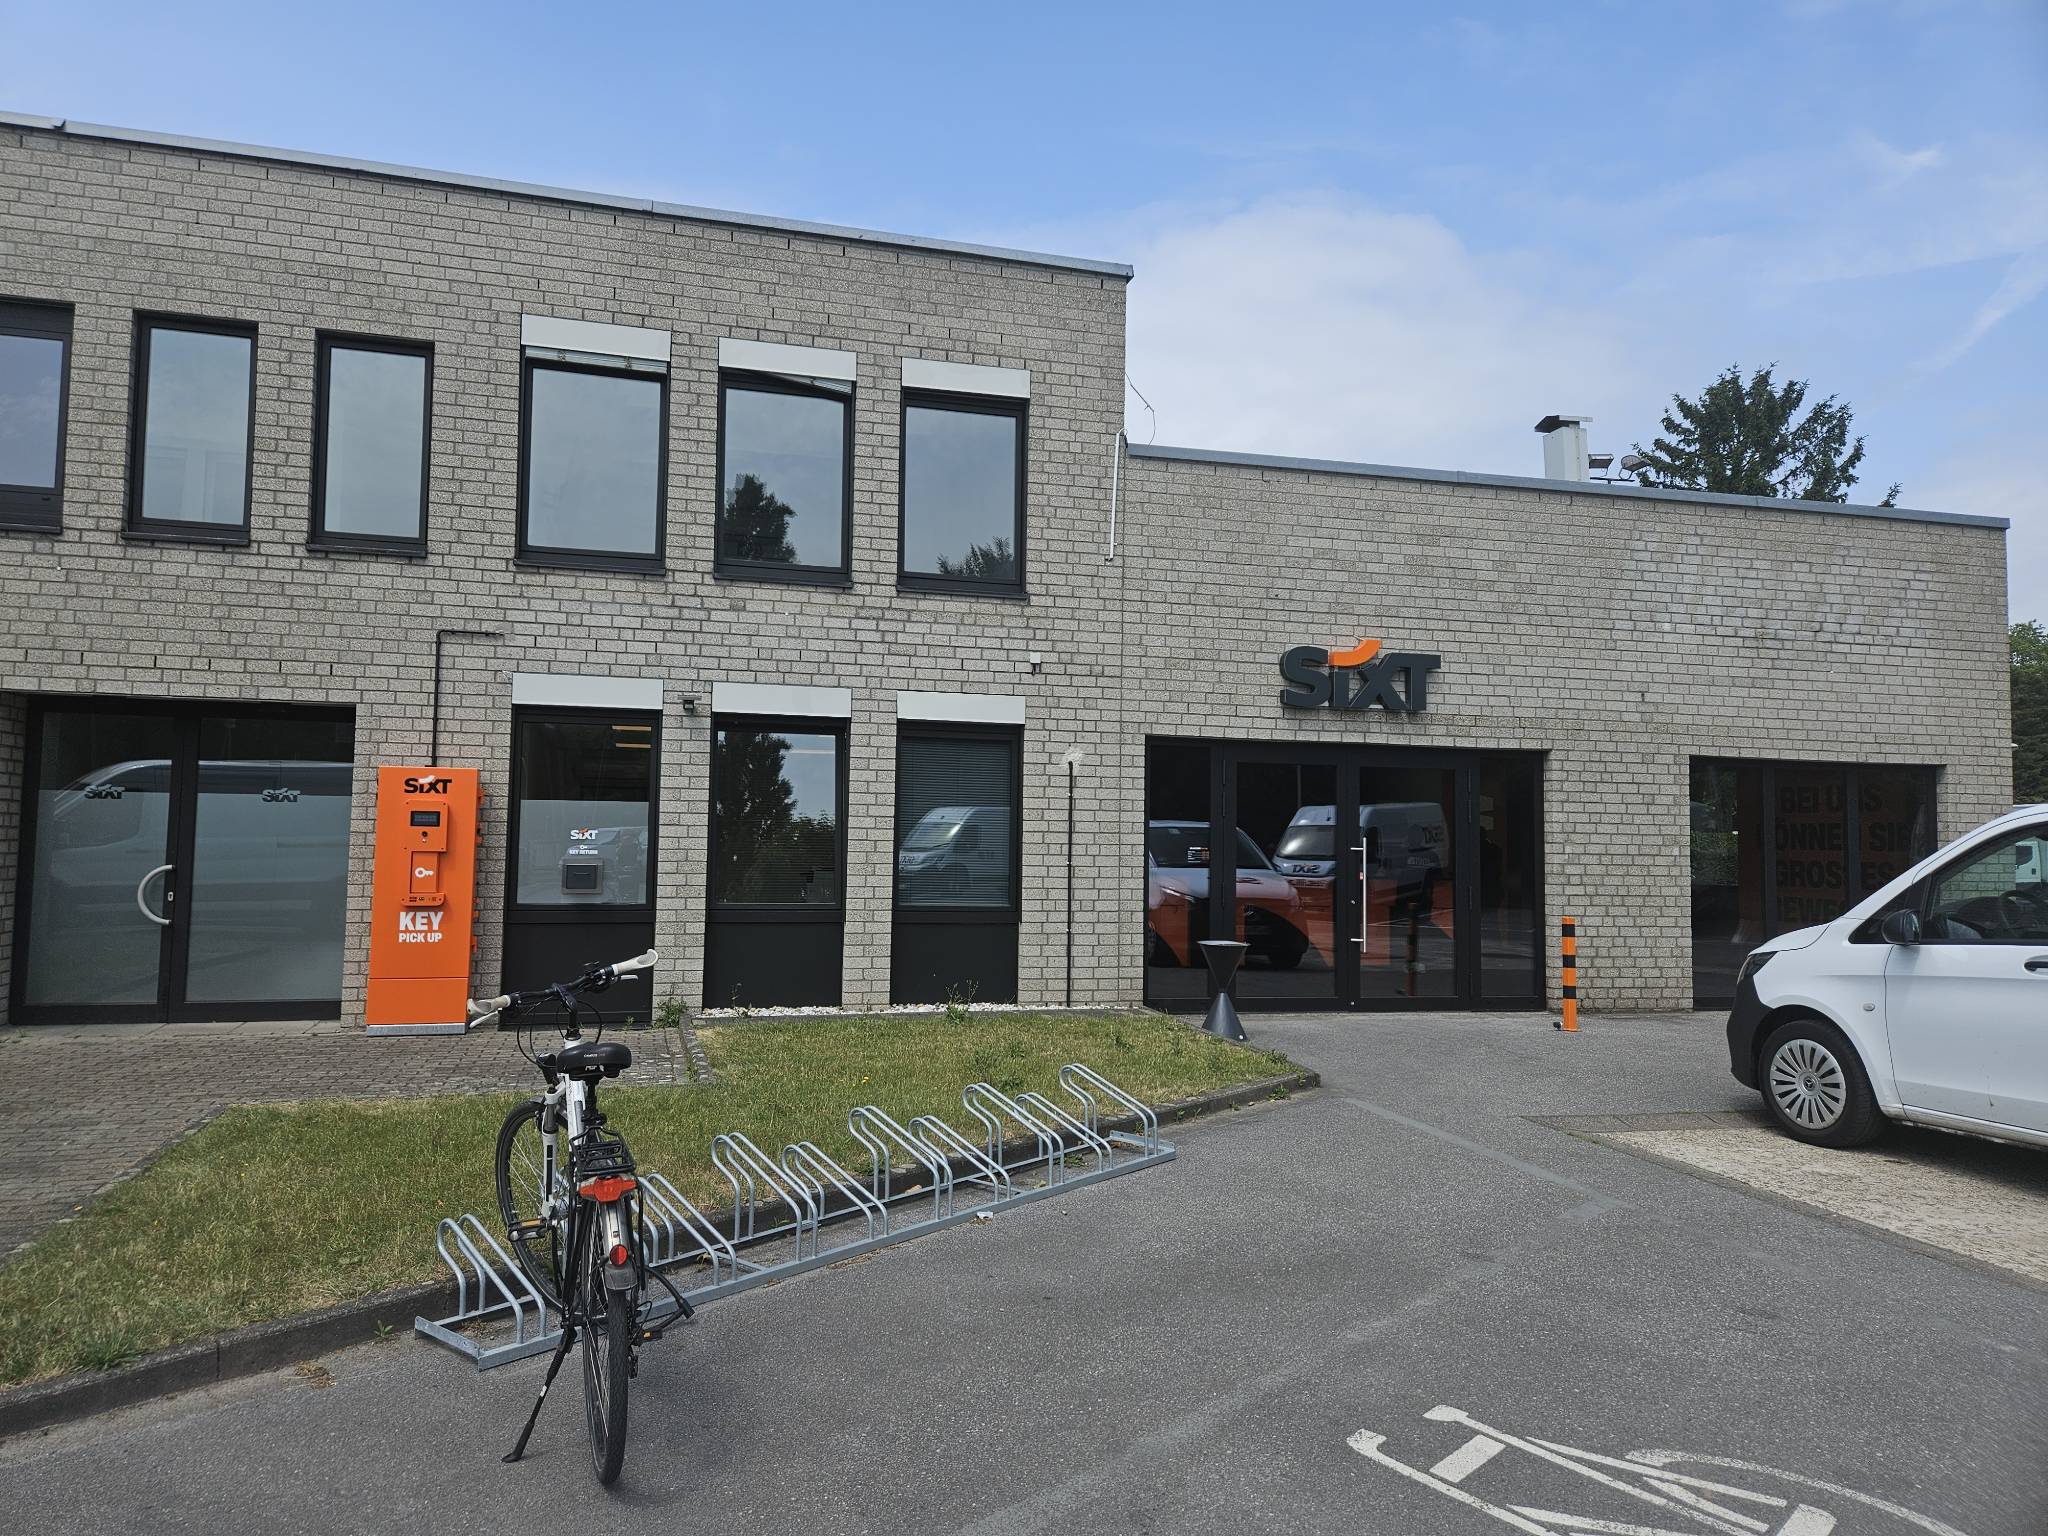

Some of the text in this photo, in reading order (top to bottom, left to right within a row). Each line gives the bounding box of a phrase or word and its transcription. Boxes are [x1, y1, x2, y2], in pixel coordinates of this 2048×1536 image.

[1279, 639, 1442, 712] SIXT
[404, 775, 452, 794] SIXT
[1825, 784, 1882, 813] US
[570, 827, 599, 840] SIXT
[399, 911, 444, 931] KEY
[399, 932, 443, 943] PICK UP
